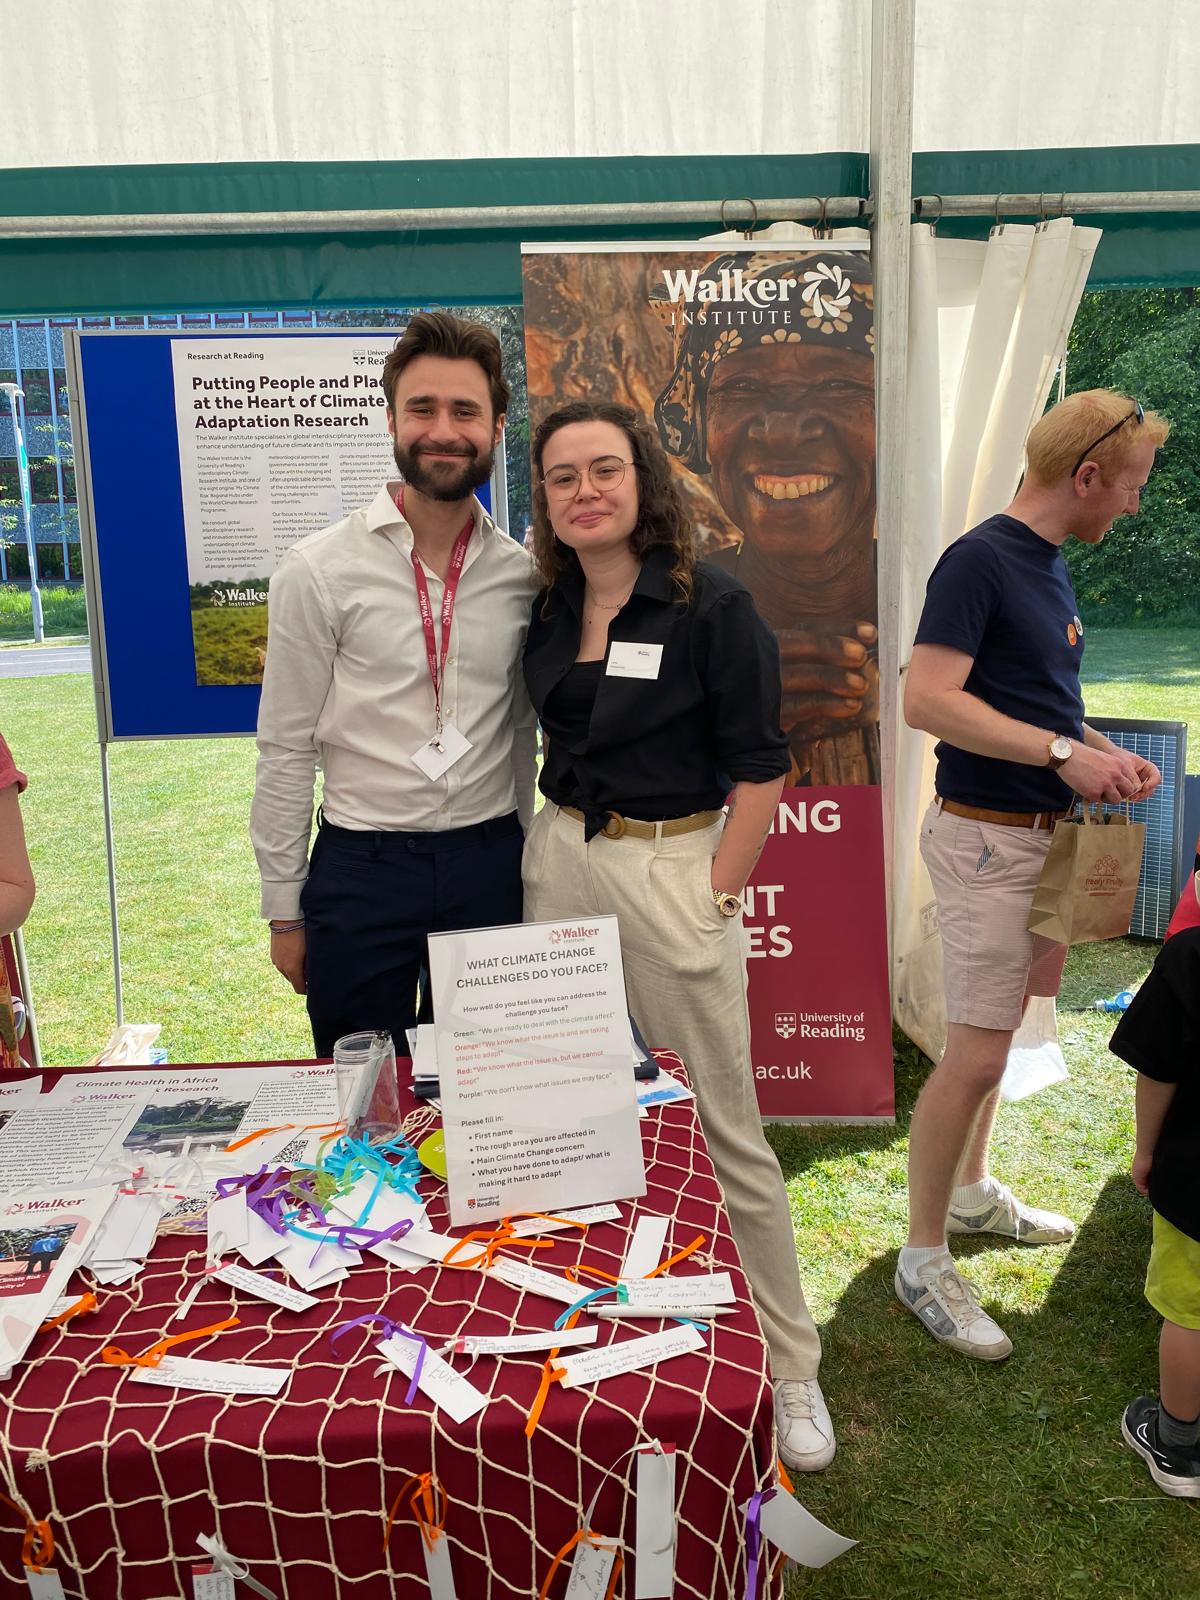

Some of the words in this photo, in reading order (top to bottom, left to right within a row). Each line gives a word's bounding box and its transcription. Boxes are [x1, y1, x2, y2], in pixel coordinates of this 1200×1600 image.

[662, 268, 797, 308] Walker
[671, 310, 792, 326] INSTITUTE
[187, 352, 223, 360] Research
[233, 352, 264, 361] Reading
[192, 376, 256, 393] Putting
[259, 375, 315, 393] People
[319, 374, 349, 389] and
[353, 374, 384, 389] Plac
[193, 396, 211, 410] at
[214, 396, 244, 409] the
[247, 395, 296, 409] Heart
[299, 394, 317, 408] of
[320, 394, 385, 408] Climate
[195, 414, 290, 431] Adaptation
[293, 413, 369, 427] Research
[311, 432, 357, 440] interdisciplinary
[222, 442, 264, 450] understanding
[420, 589, 428, 618] Walker
[442, 590, 453, 617] Walker
[742, 884, 785, 918] NT
[561, 926, 600, 939] Walker
[744, 924, 794, 958] ES
[466, 957, 500, 970] WHAT
[501, 952, 548, 967] CLIMATE
[549, 946, 596, 960] CHANGE
[456, 971, 530, 989] CHALLENGES
[532, 969, 549, 980] DO
[550, 966, 574, 978] YOU
[576, 962, 608, 975] FACE?
[480, 1003, 494, 1011] well
[494, 1002, 504, 1010] do
[504, 1002, 516, 1010] you
[544, 996, 556, 1005] you
[570, 991, 596, 1000] address
[505, 1009, 537, 1018] challenge
[538, 1008, 550, 1016] you
[551, 1004, 568, 1012] face?
[800, 1012, 851, 1024] University
[853, 1011, 864, 1023] of
[504, 1024, 522, 1032] ready
[530, 1020, 544, 1028] deal
[570, 1014, 594, 1022] climate
[496, 1038, 515, 1046] know
[542, 1032, 558, 1040] issue
[590, 1026, 609, 1034] taking
[801, 1024, 866, 1042] Reading
[456, 1054, 474, 1062] steps
[506, 1060, 522, 1068] what
[560, 1054, 571, 1062] but
[582, 1050, 604, 1058] cannot
[307, 1068, 336, 1076] Walk
[76, 1080, 122, 1088] Climate
[125, 1078, 165, 1086] Health
[182, 1076, 218, 1084] Africa
[458, 1091, 483, 1100] Purple:
[498, 1086, 515, 1094] don't
[534, 1081, 550, 1089] what
[550, 1078, 571, 1086] issues
[582, 1075, 596, 1083] may
[0, 1088, 22, 1096] ker
[461, 1118, 484, 1127] Please
[484, 1116, 494, 1124] fill
[474, 1132, 492, 1140] First
[490, 1141, 512, 1150] rough
[512, 1139, 529, 1147] area
[530, 1138, 544, 1146] you
[558, 1130, 588, 1140] affected
[476, 1156, 494, 1164] Main
[496, 1152, 525, 1162] Climate
[526, 1148, 554, 1158] Change
[555, 1144, 585, 1153] concern
[477, 1168, 498, 1176] What
[498, 1166, 512, 1174] you
[513, 1163, 531, 1172] have
[532, 1160, 551, 1168] done
[560, 1154, 585, 1164] adapt/
[585, 1152, 604, 1160] what
[478, 1178, 506, 1188] making
[513, 1174, 531, 1183] hard
[540, 1170, 562, 1178] adapt
[27, 1198, 86, 1210] Walker
[476, 1200, 501, 1208] Reading
